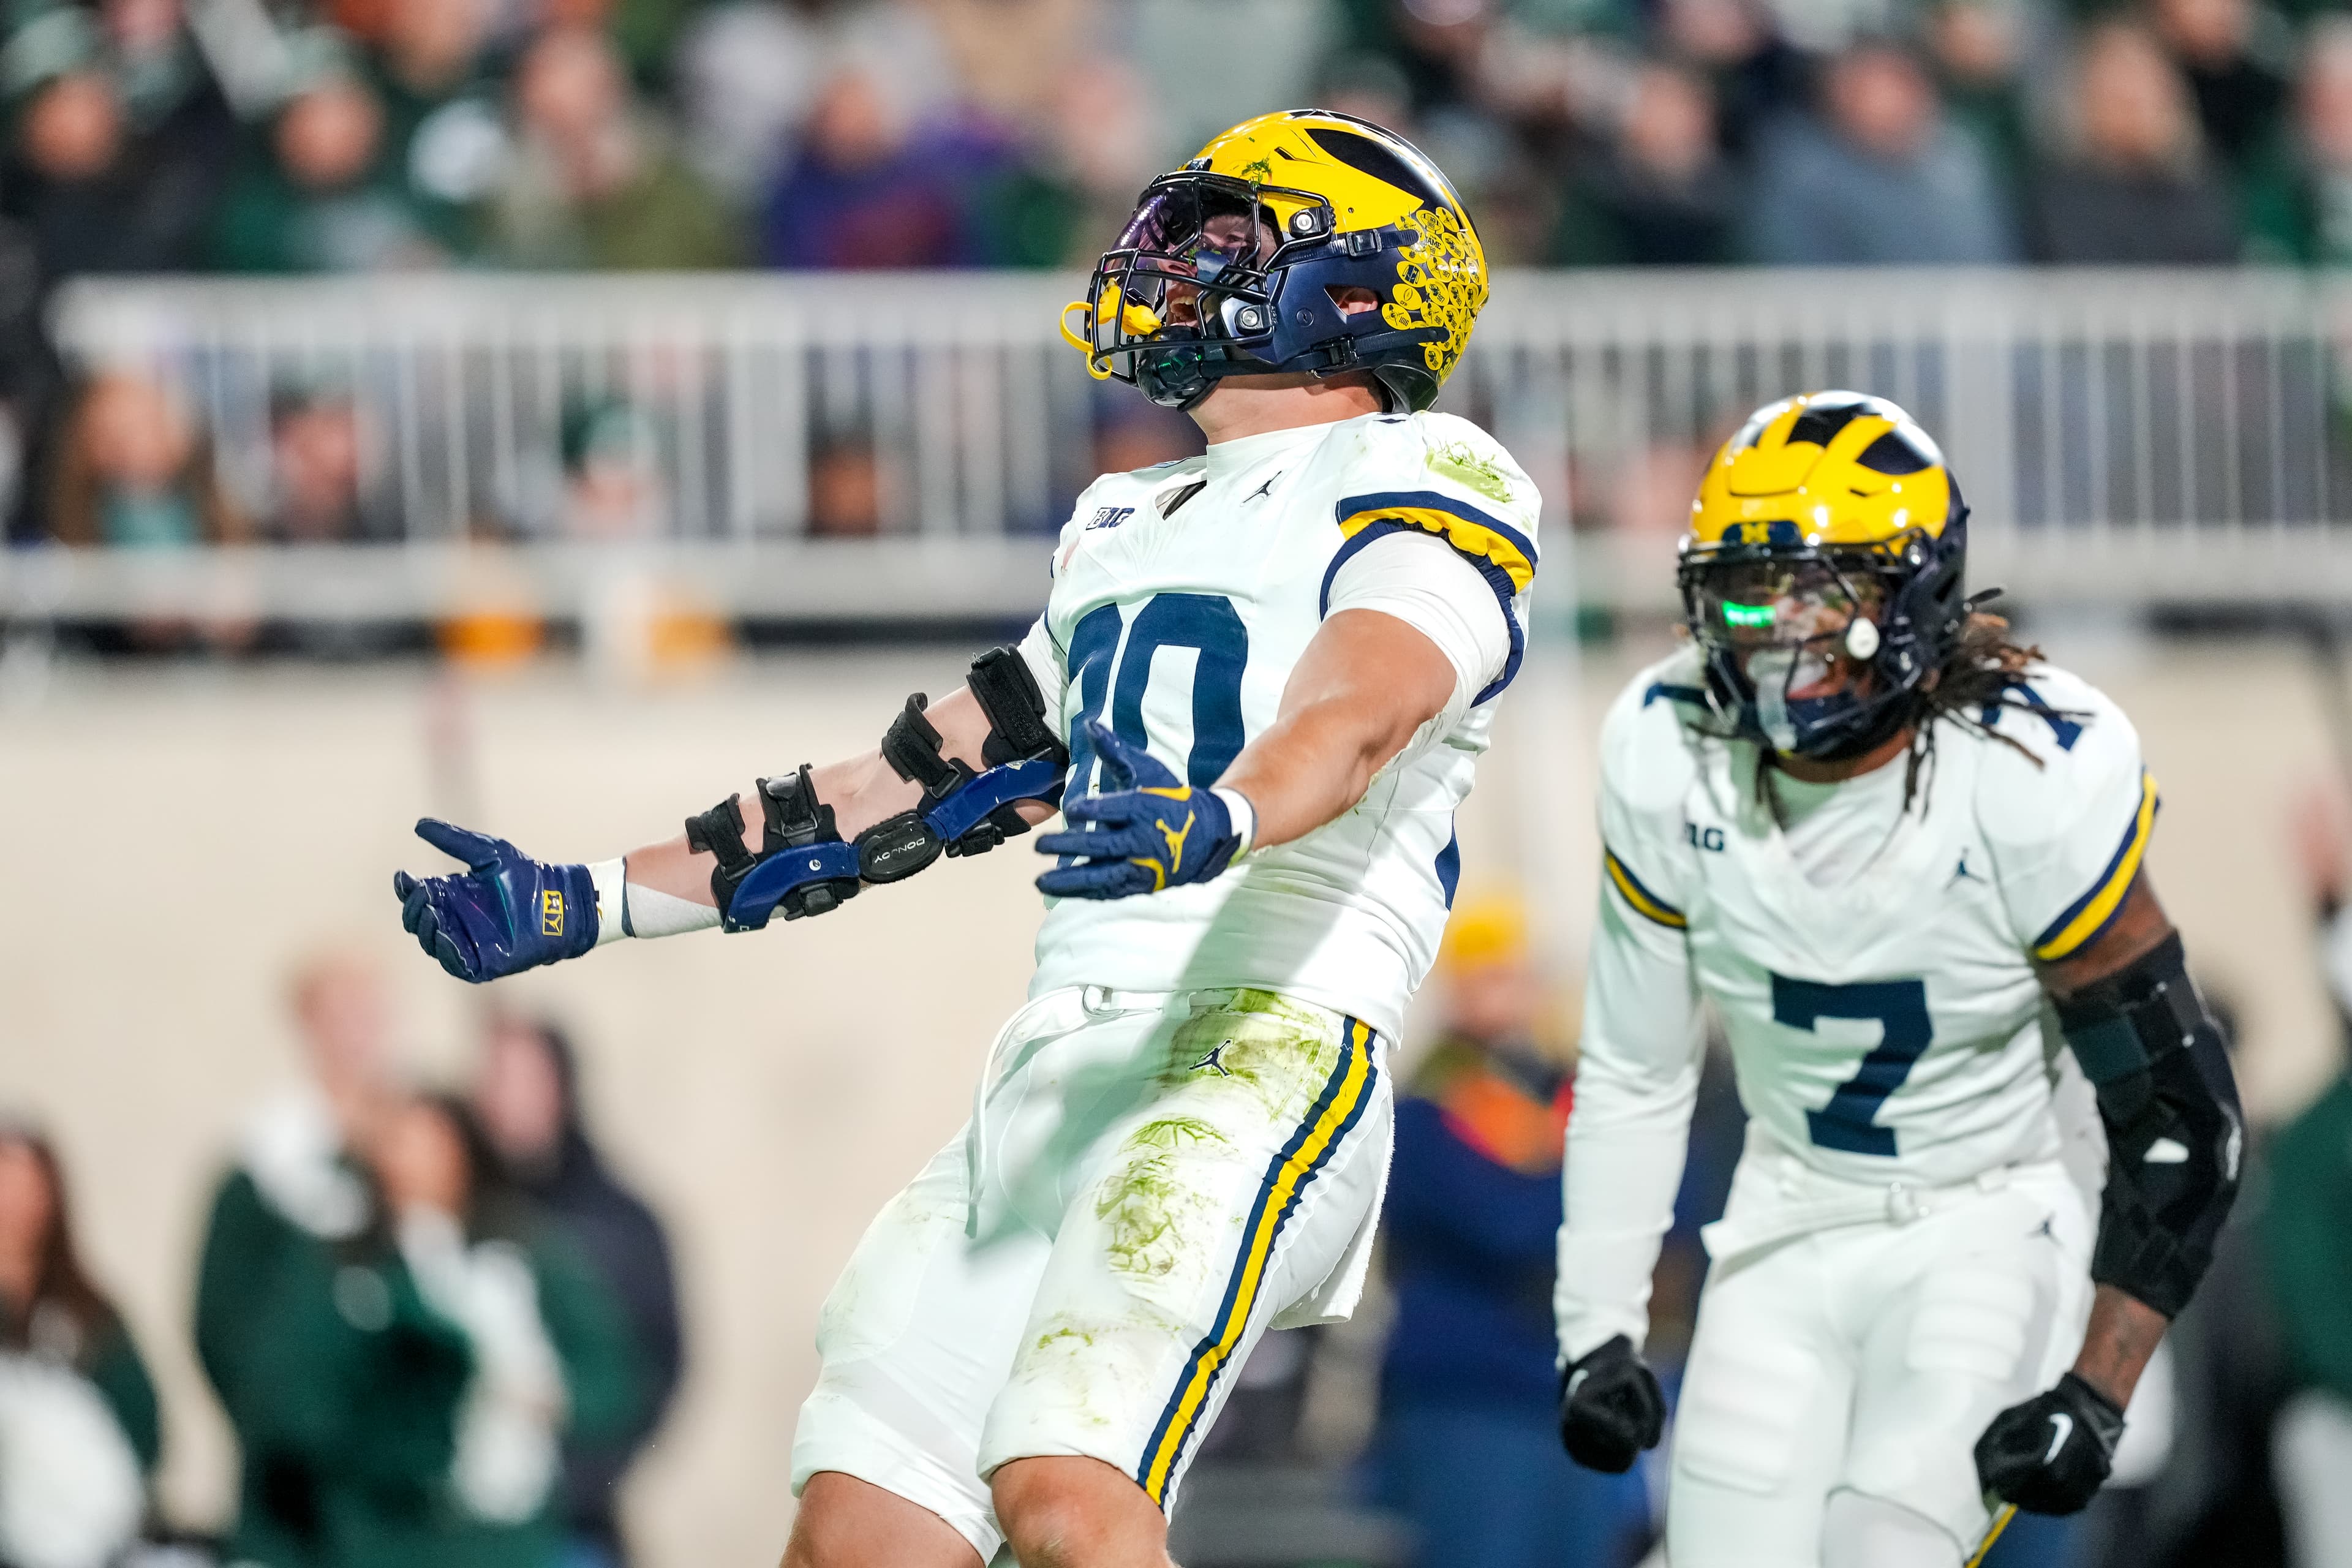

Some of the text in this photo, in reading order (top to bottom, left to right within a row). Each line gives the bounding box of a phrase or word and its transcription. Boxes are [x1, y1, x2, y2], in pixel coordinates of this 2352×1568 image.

[1428, 238, 1441, 250] AME
[1399, 317, 1409, 326] 1016
[1770, 971, 1934, 1157] 7
